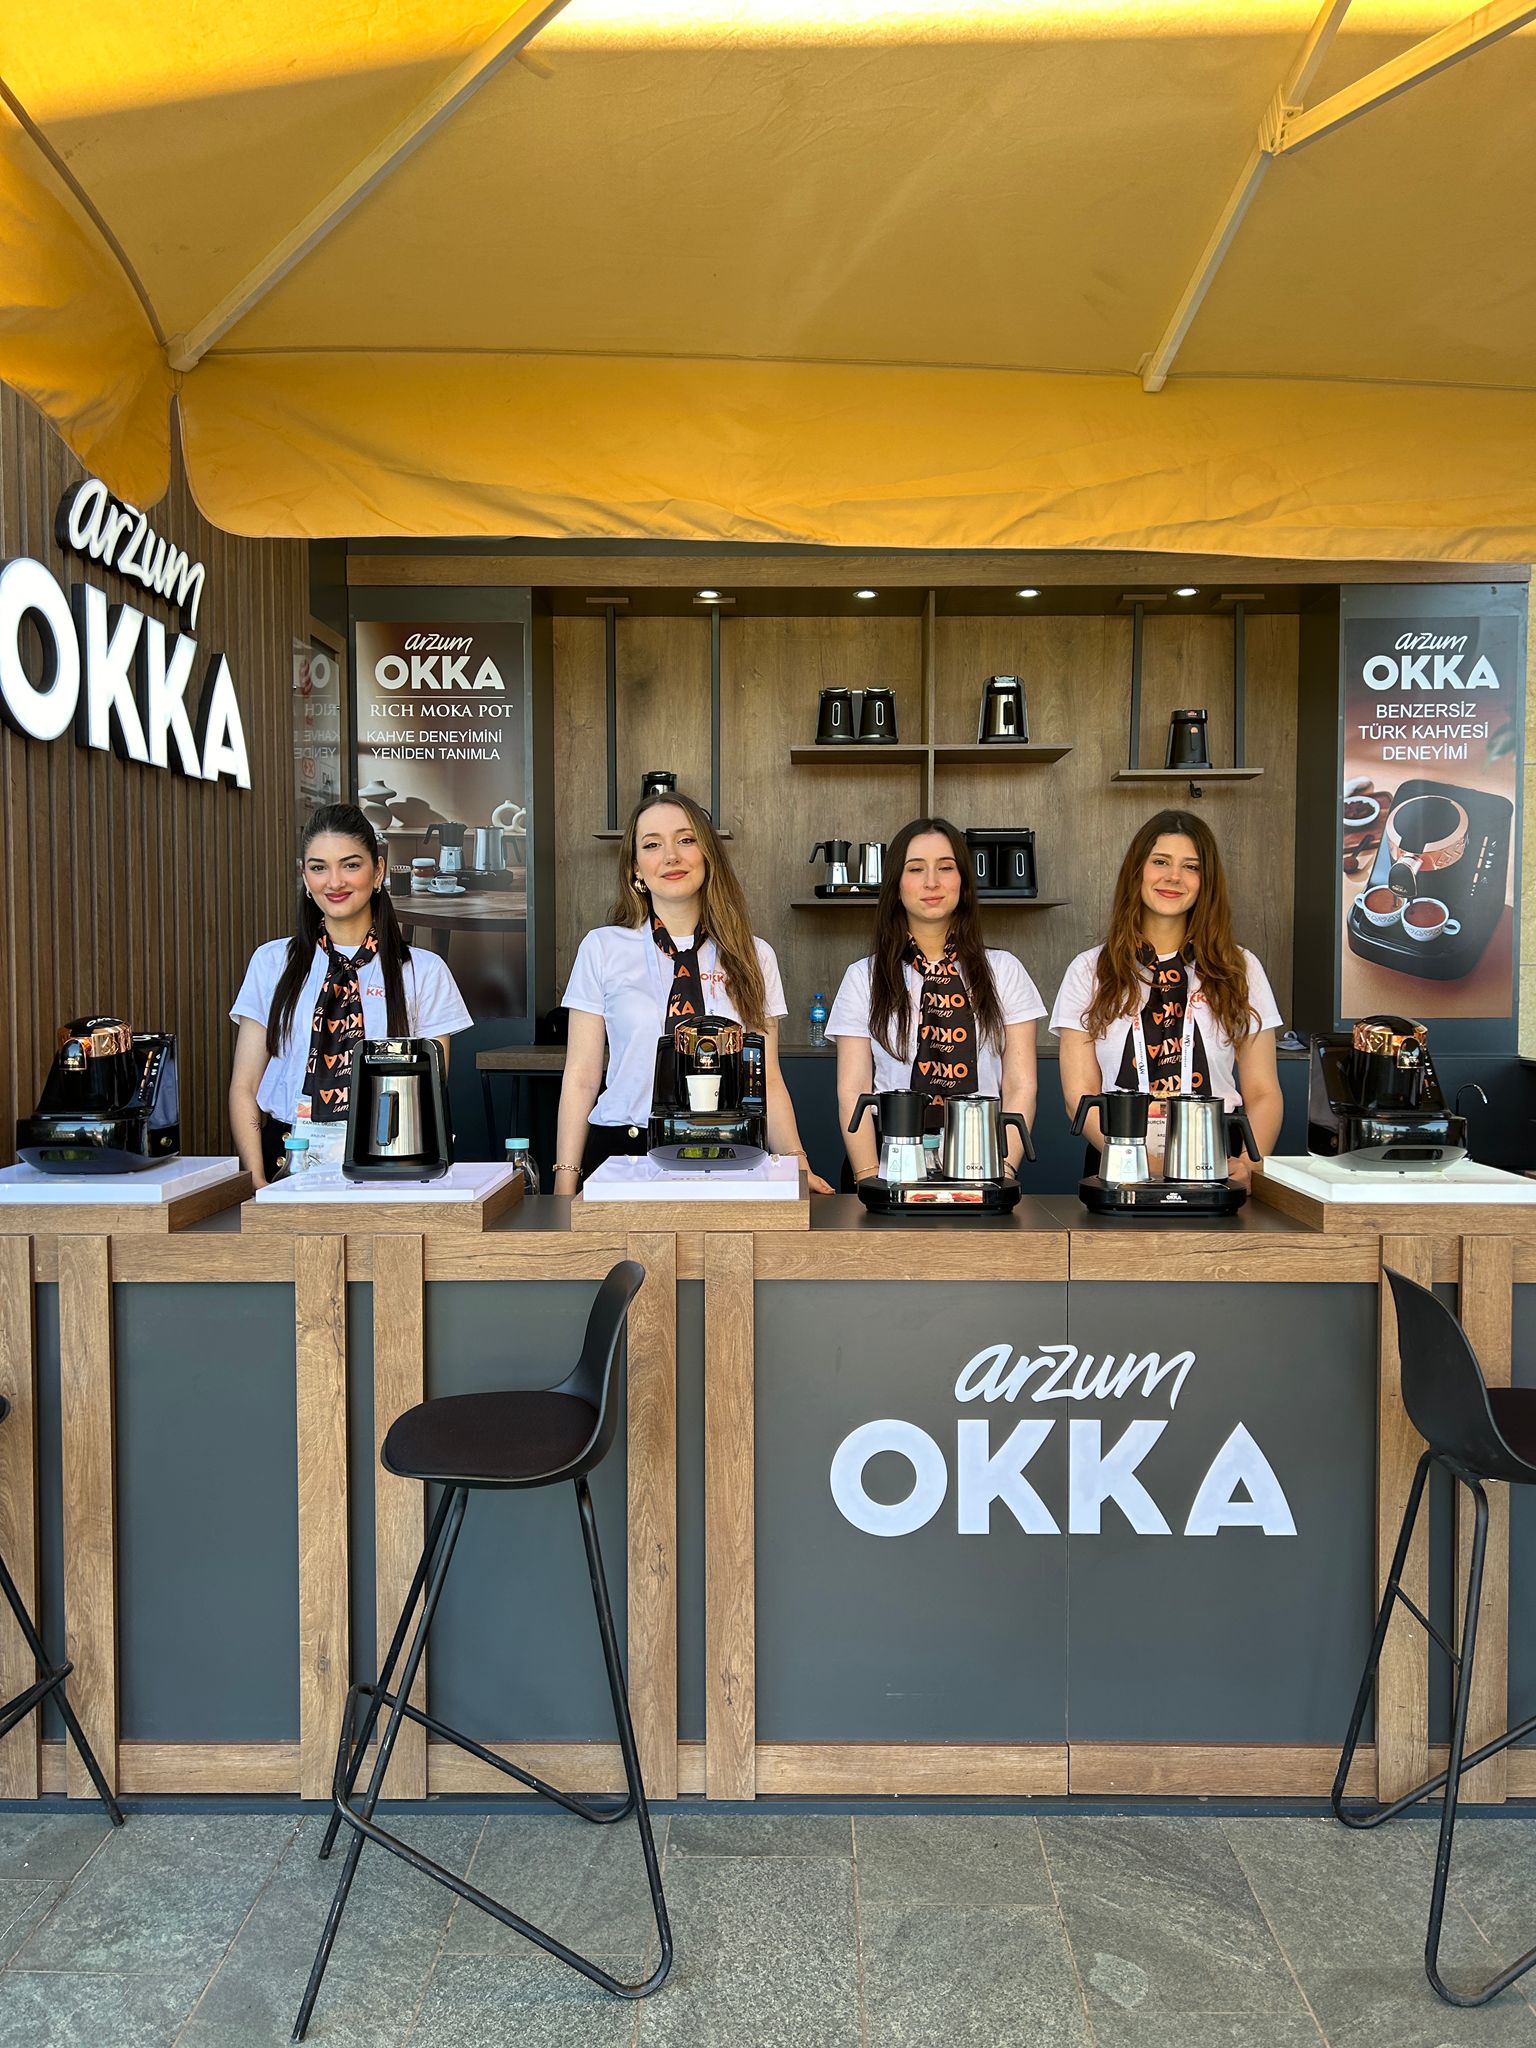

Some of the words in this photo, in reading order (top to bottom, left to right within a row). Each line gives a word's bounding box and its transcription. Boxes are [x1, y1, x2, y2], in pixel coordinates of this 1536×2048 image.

[68, 478, 206, 632] arzum
[404, 633, 474, 655] arzum
[1394, 632, 1468, 654] arzum
[0, 557, 252, 790] OKKA
[374, 654, 506, 691] OKKA
[1362, 655, 1500, 691] OKKA
[370, 703, 415, 718] RICH
[420, 703, 474, 718] MOKA
[478, 703, 514, 719] POT
[1375, 700, 1477, 719] BENZERSİZ
[366, 729, 415, 744] KAHVE
[418, 727, 503, 744] DENEYİMİNİ
[1358, 722, 1407, 740] TÜRK
[1411, 721, 1489, 740] KAHVESİ
[371, 745, 437, 761] YENİDEN
[438, 747, 501, 761] TANIMLA
[1382, 742, 1468, 761] DENEYİMİ
[917, 1060, 969, 1079] OKKA
[954, 1343, 1196, 1411] arzum
[829, 1418, 1299, 1538] OKKA
